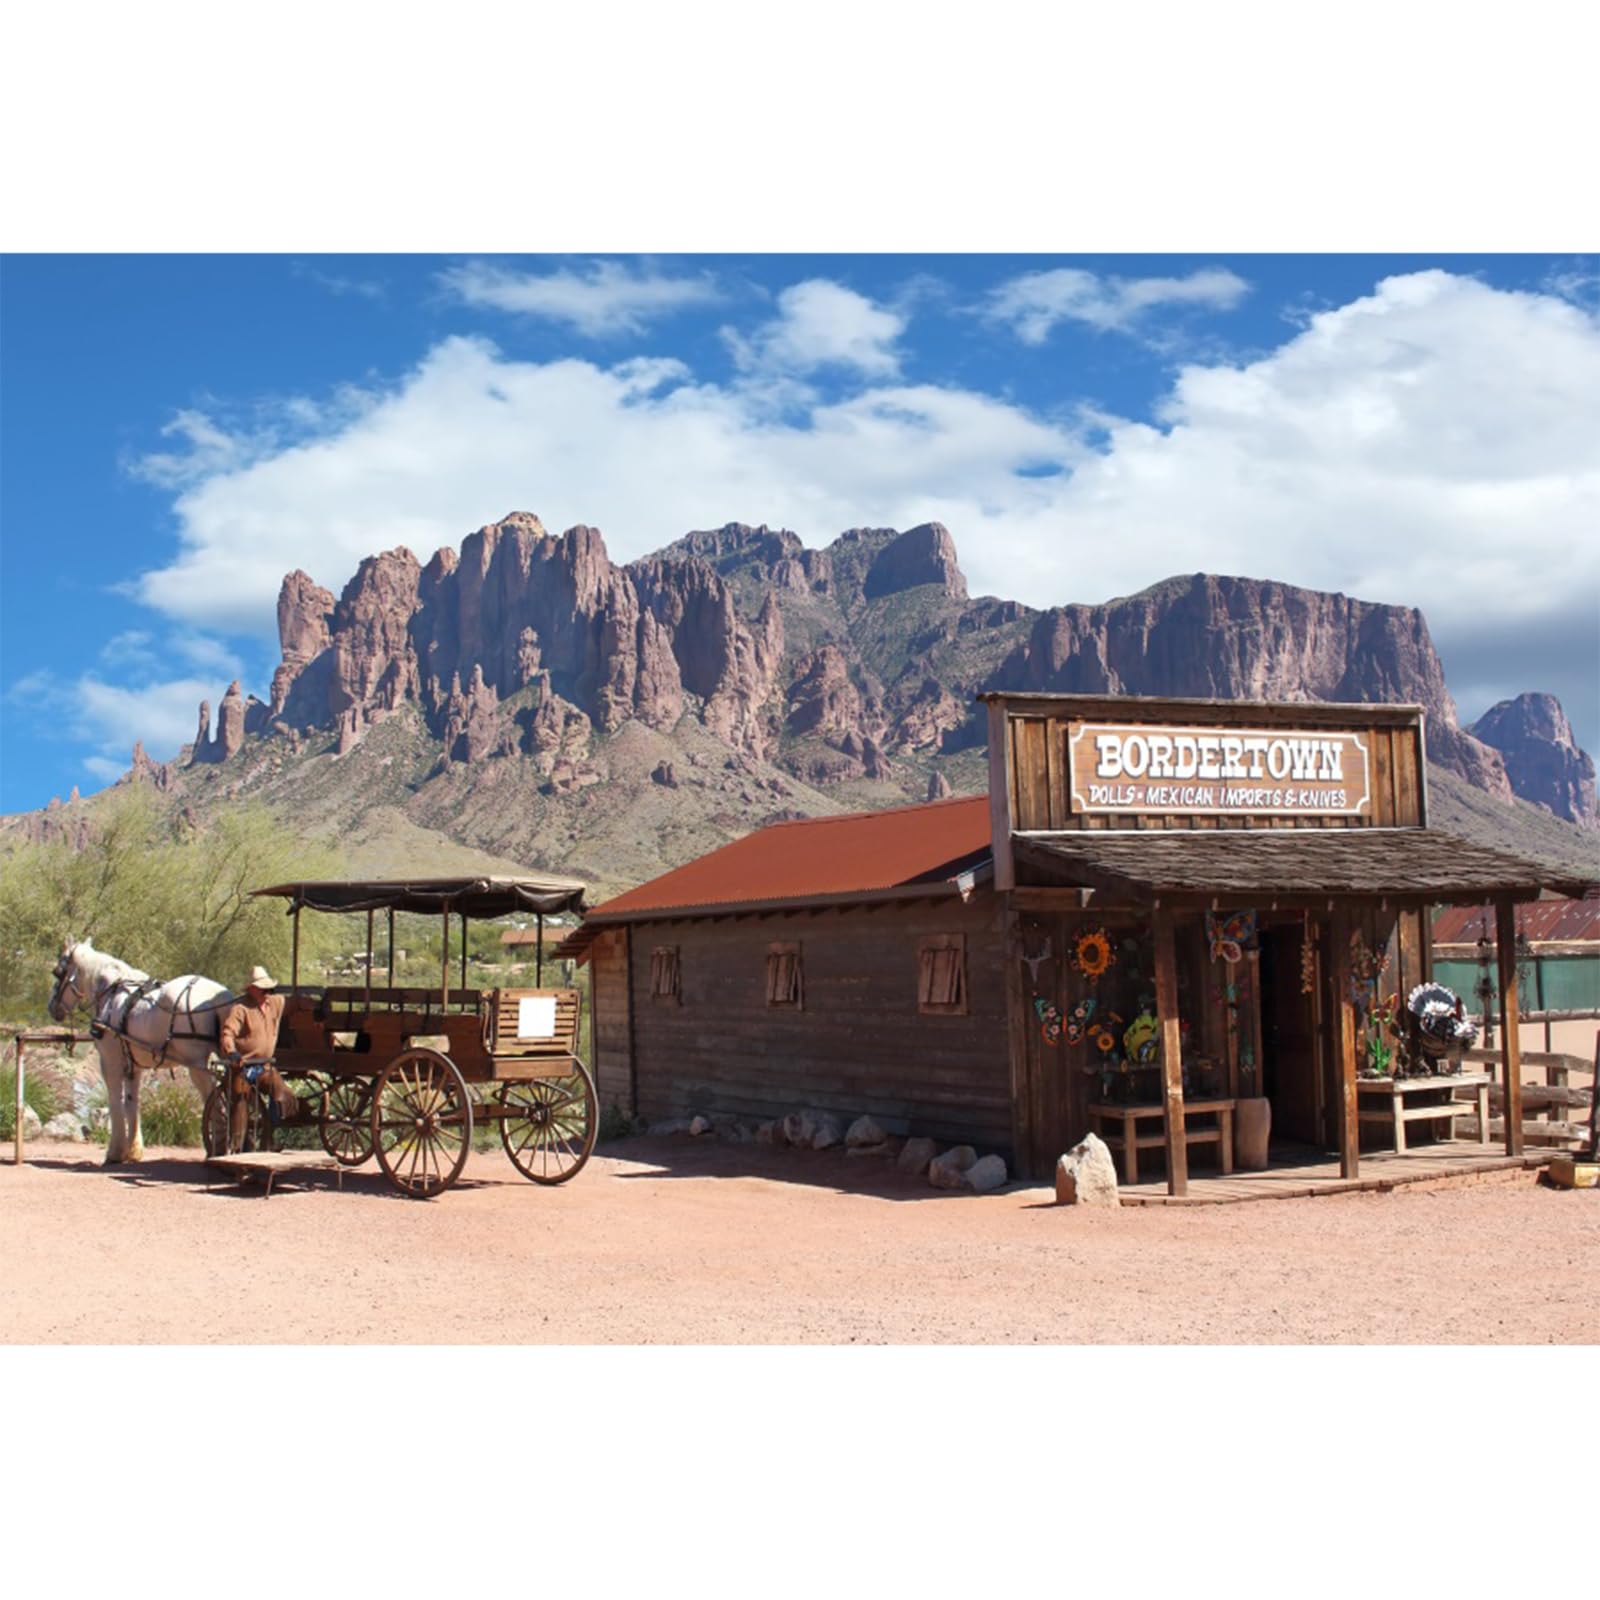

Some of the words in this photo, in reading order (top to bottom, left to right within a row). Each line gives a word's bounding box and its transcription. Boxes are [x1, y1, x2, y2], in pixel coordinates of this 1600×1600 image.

[1096, 735, 1343, 780] BORDERTOWN
[1089, 785, 1136, 804] DOLLS
[1146, 786, 1213, 805] MEXICAN
[1220, 787, 1281, 806] IMPORTS
[1299, 789, 1346, 807] KNIVES
